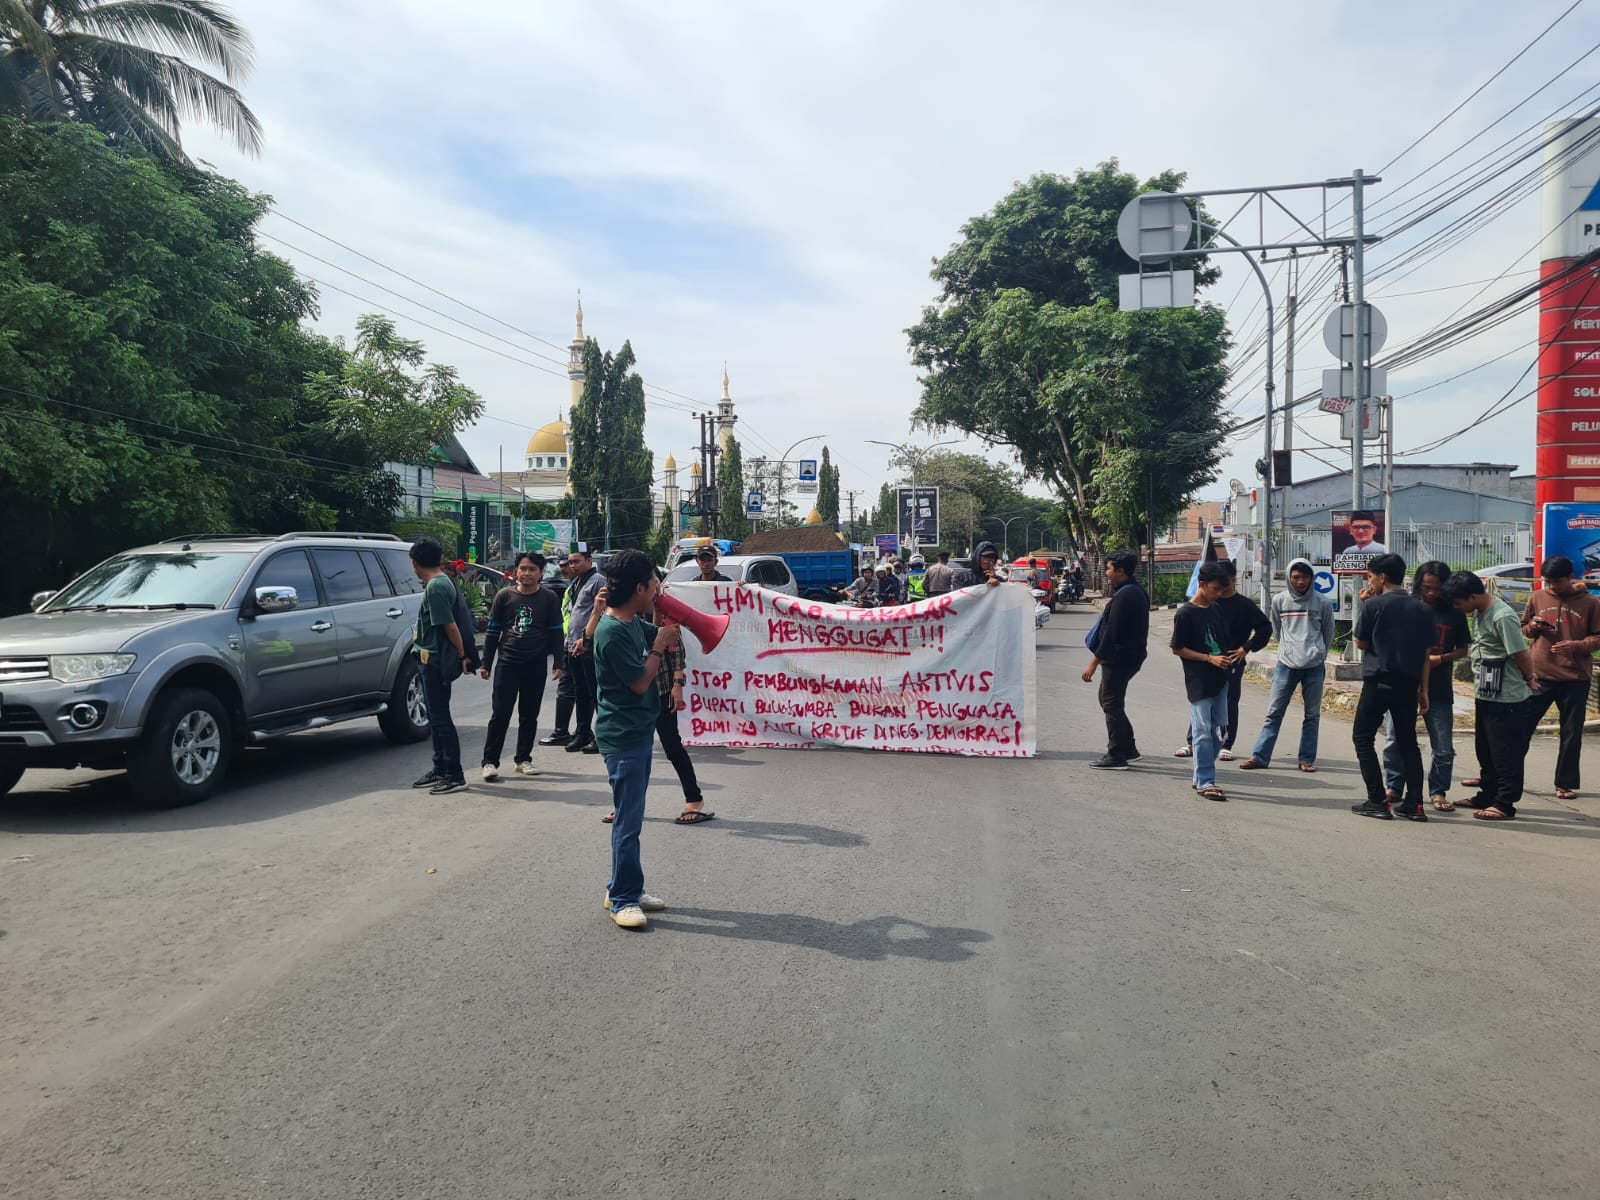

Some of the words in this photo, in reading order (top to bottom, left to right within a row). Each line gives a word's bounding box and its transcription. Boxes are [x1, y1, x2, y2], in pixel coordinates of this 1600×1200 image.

[1574, 387, 1600, 397] SOL
[1571, 422, 1600, 432] PELU
[469, 506, 478, 544] Pegadaian
[714, 586, 764, 614] HMI
[835, 596, 957, 621] TAKALAR
[691, 669, 732, 690] STOP
[899, 669, 993, 696] AKTIVIS
[691, 693, 744, 714] BUPATI
[849, 701, 907, 719] BUKAN
[916, 700, 1016, 720] PENGUASA
[691, 717, 729, 737] BUMI
[811, 721, 867, 741] KRITIK
